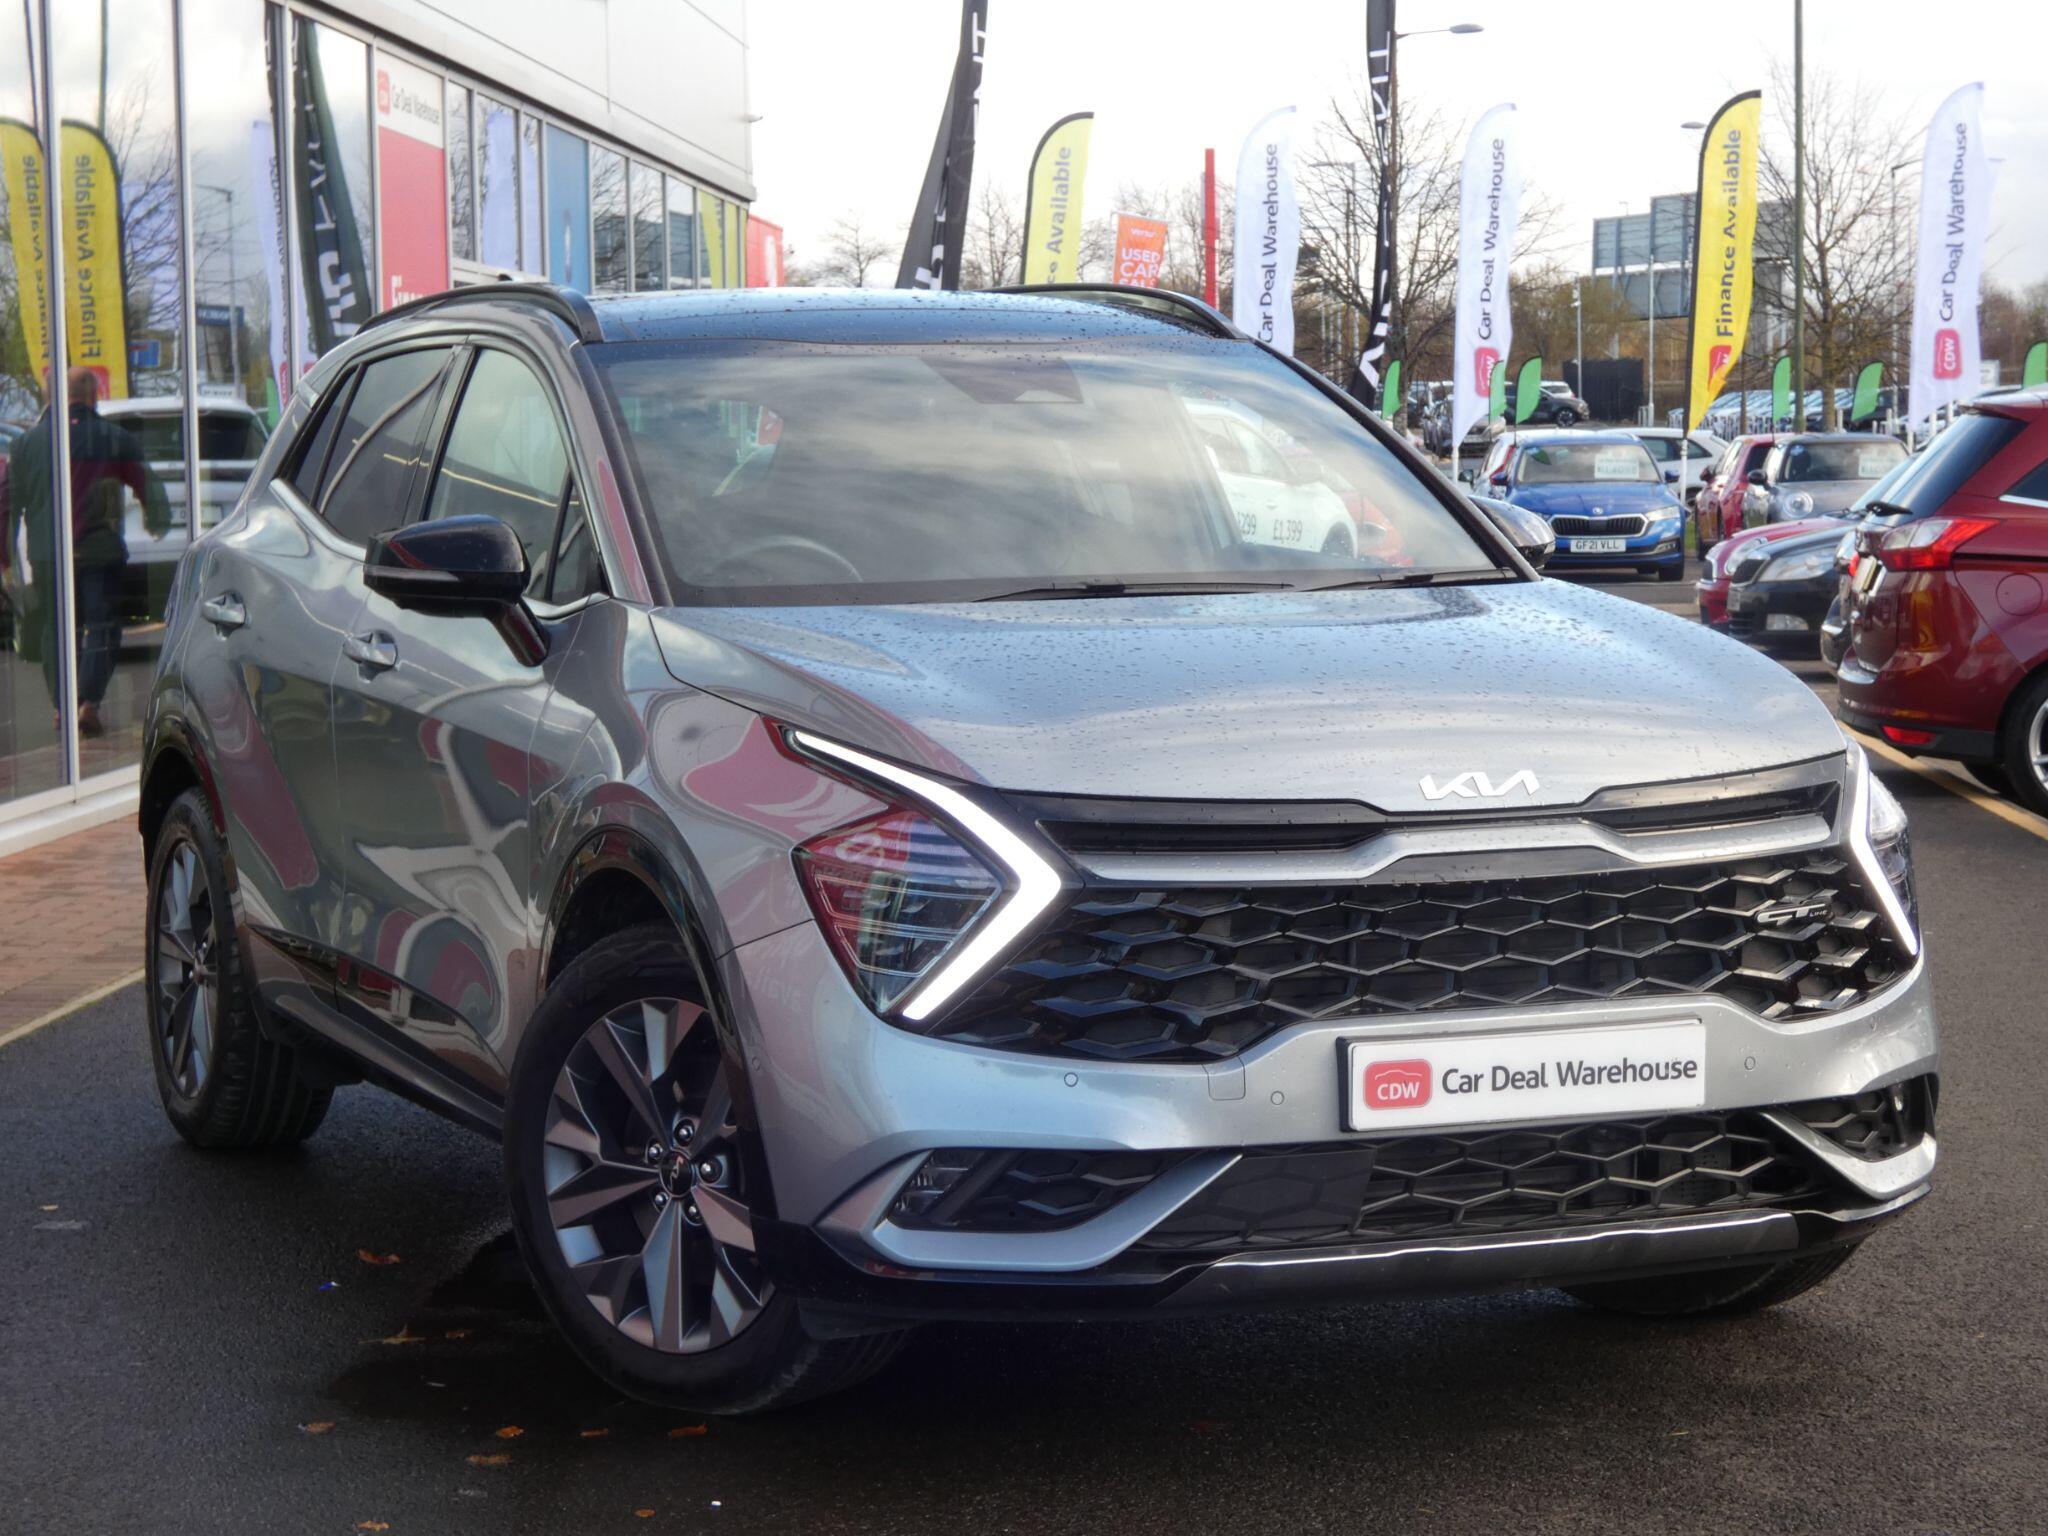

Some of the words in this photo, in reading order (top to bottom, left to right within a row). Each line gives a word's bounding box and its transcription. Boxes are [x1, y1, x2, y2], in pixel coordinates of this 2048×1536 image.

[1046, 147, 1071, 255] Available
[1262, 144, 1278, 257] Warehouse
[1484, 137, 1505, 251] Warehouse
[1723, 129, 1741, 239] Available
[1947, 123, 1967, 236] Warehouse
[1120, 261, 1159, 278] CAR
[1121, 247, 1160, 263] USED
[1942, 242, 1964, 284] Deal
[1260, 262, 1277, 307] Deal
[1480, 257, 1495, 303] Deal
[1716, 246, 1736, 338] Finance
[1478, 308, 1492, 341] Car
[1939, 289, 1954, 322] Car
[1258, 312, 1273, 344] Car
[1943, 337, 1956, 371] CDW
[1600, 540, 1620, 550] VLL
[1418, 769, 1541, 801] KIA
[1376, 1081, 1420, 1101] CDW
[1441, 1068, 1484, 1095] Car
[1491, 1062, 1550, 1092] Deal
[1556, 1056, 1699, 1088] Warehouse
